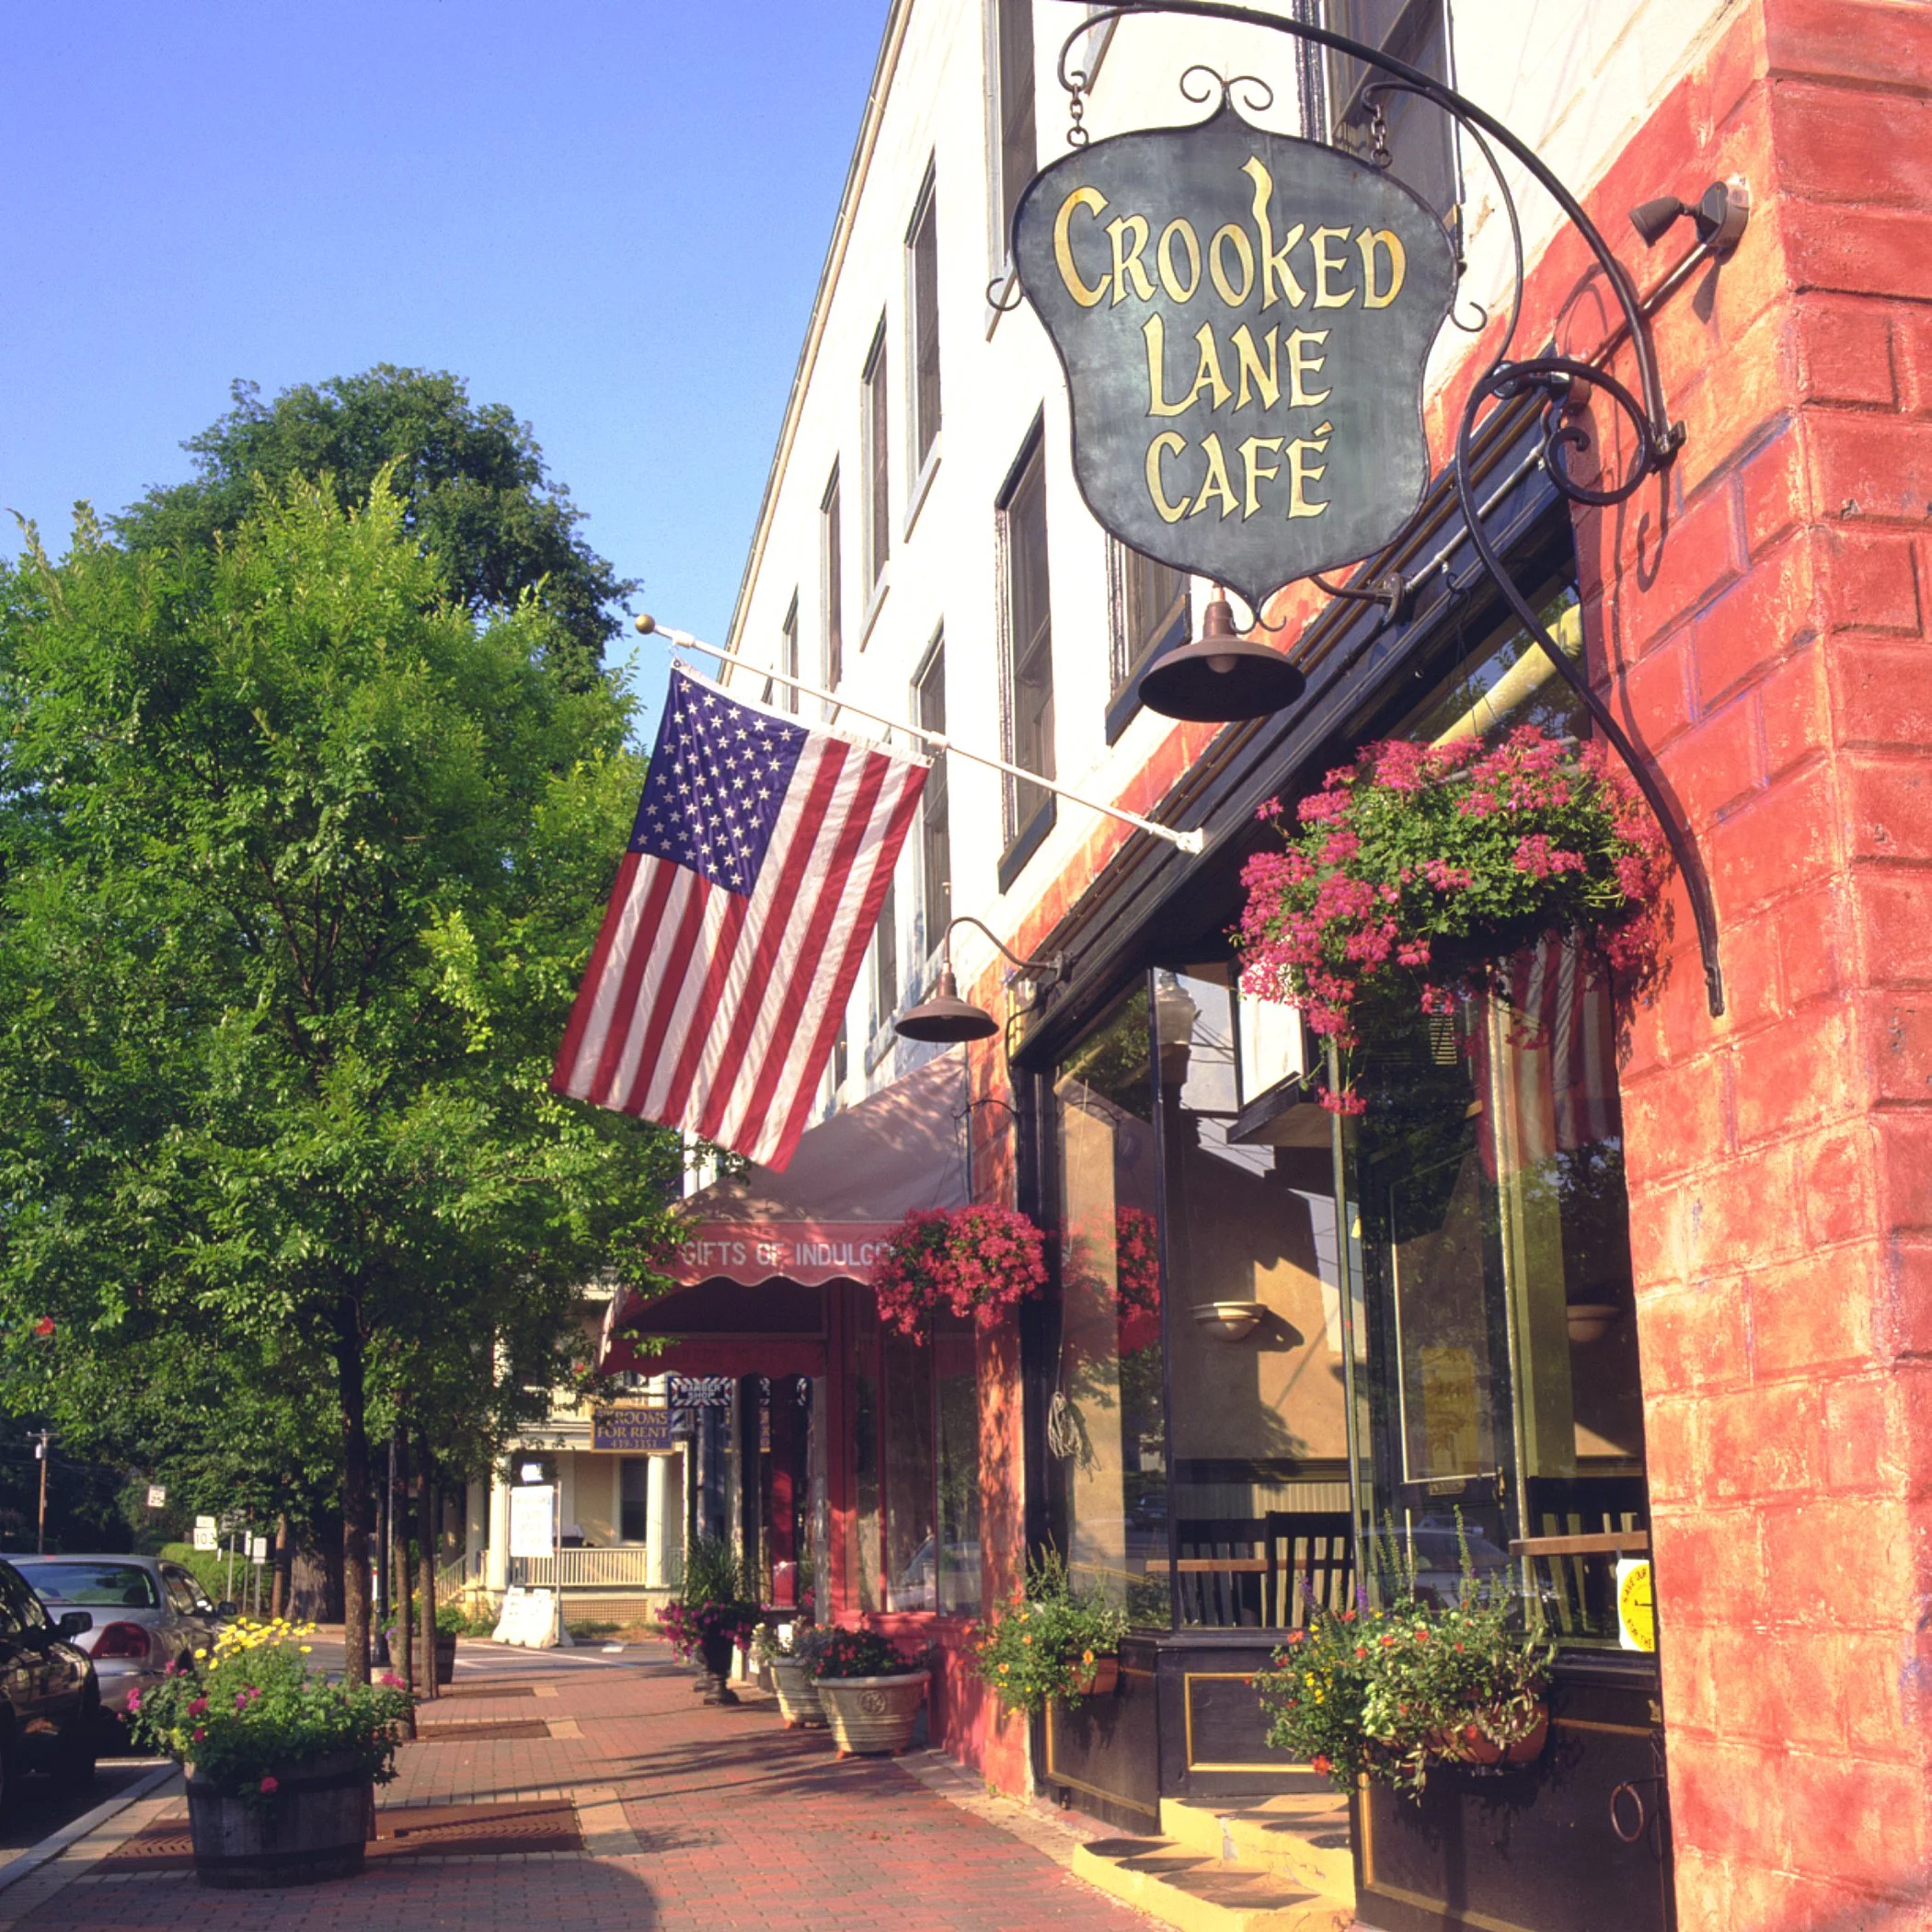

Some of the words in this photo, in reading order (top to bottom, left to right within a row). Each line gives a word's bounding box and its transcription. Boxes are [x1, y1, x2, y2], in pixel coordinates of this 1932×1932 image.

[1053, 155, 1407, 313] CROOKED
[1142, 312, 1332, 418] LANE
[1145, 420, 1334, 523] CAFÉ
[681, 1241, 746, 1266] GIFTS
[756, 1242, 786, 1266] OF
[680, 1383, 720, 1392] BARBER
[687, 1391, 715, 1400] SHOP
[615, 1410, 667, 1425] ROOMS
[597, 1427, 627, 1438] FOR
[630, 1427, 669, 1438] RENT
